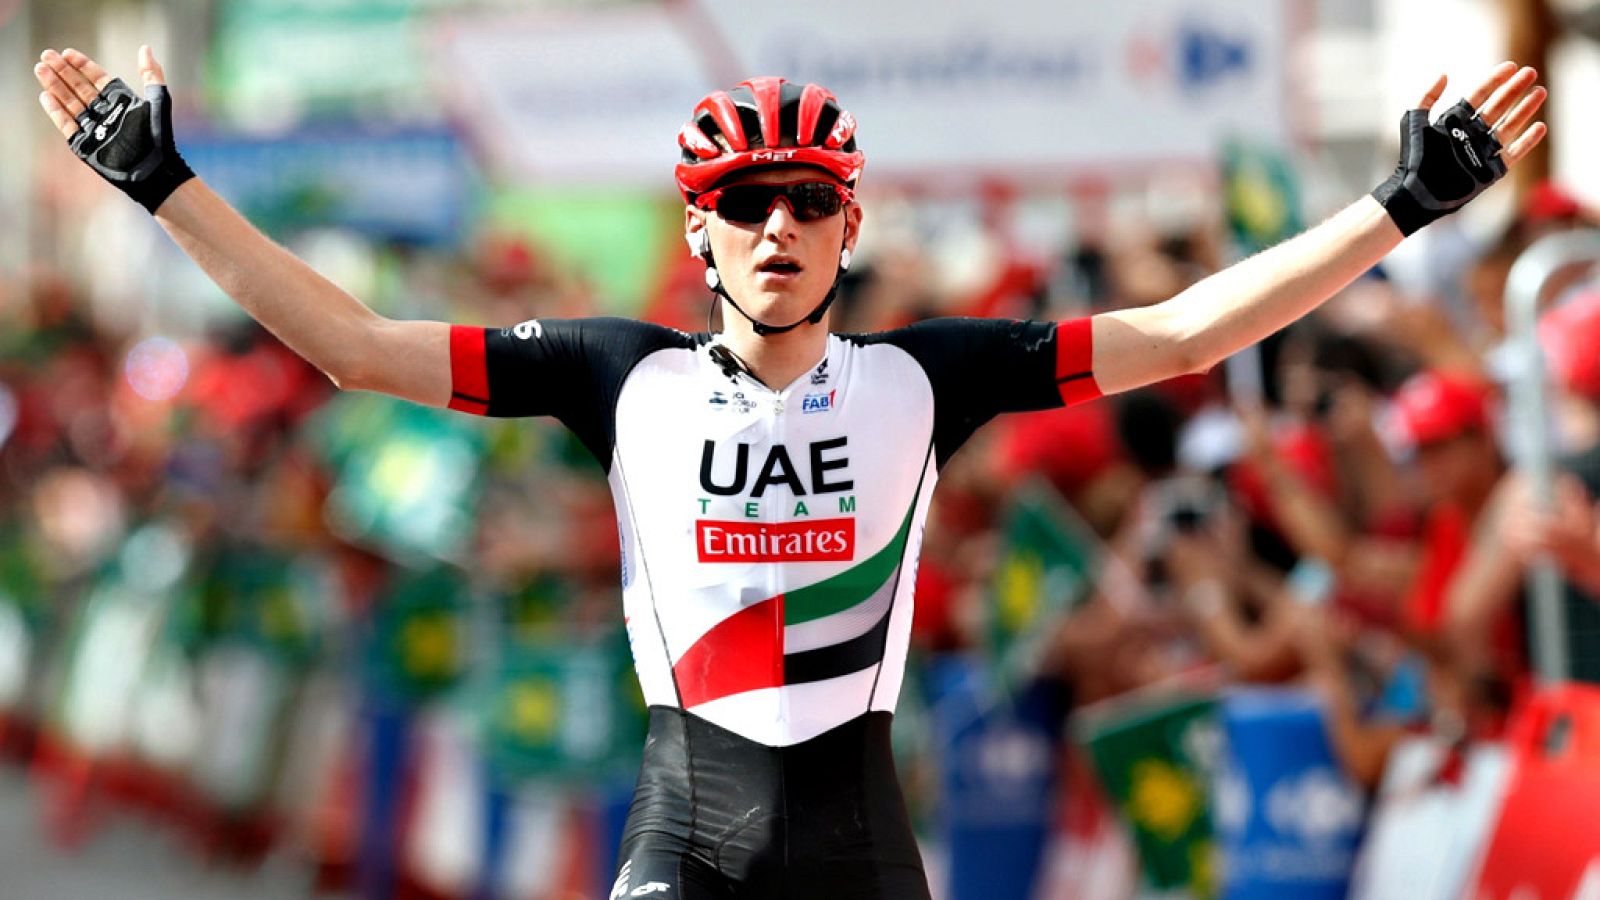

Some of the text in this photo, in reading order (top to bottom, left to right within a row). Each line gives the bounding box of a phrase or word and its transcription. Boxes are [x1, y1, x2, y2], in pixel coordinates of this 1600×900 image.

[831, 111, 856, 143] ME
[751, 150, 798, 162] MET
[802, 395, 829, 411] FAB
[699, 435, 854, 498] UAE
[697, 495, 856, 518] TEAM
[702, 526, 849, 556] Emirates
